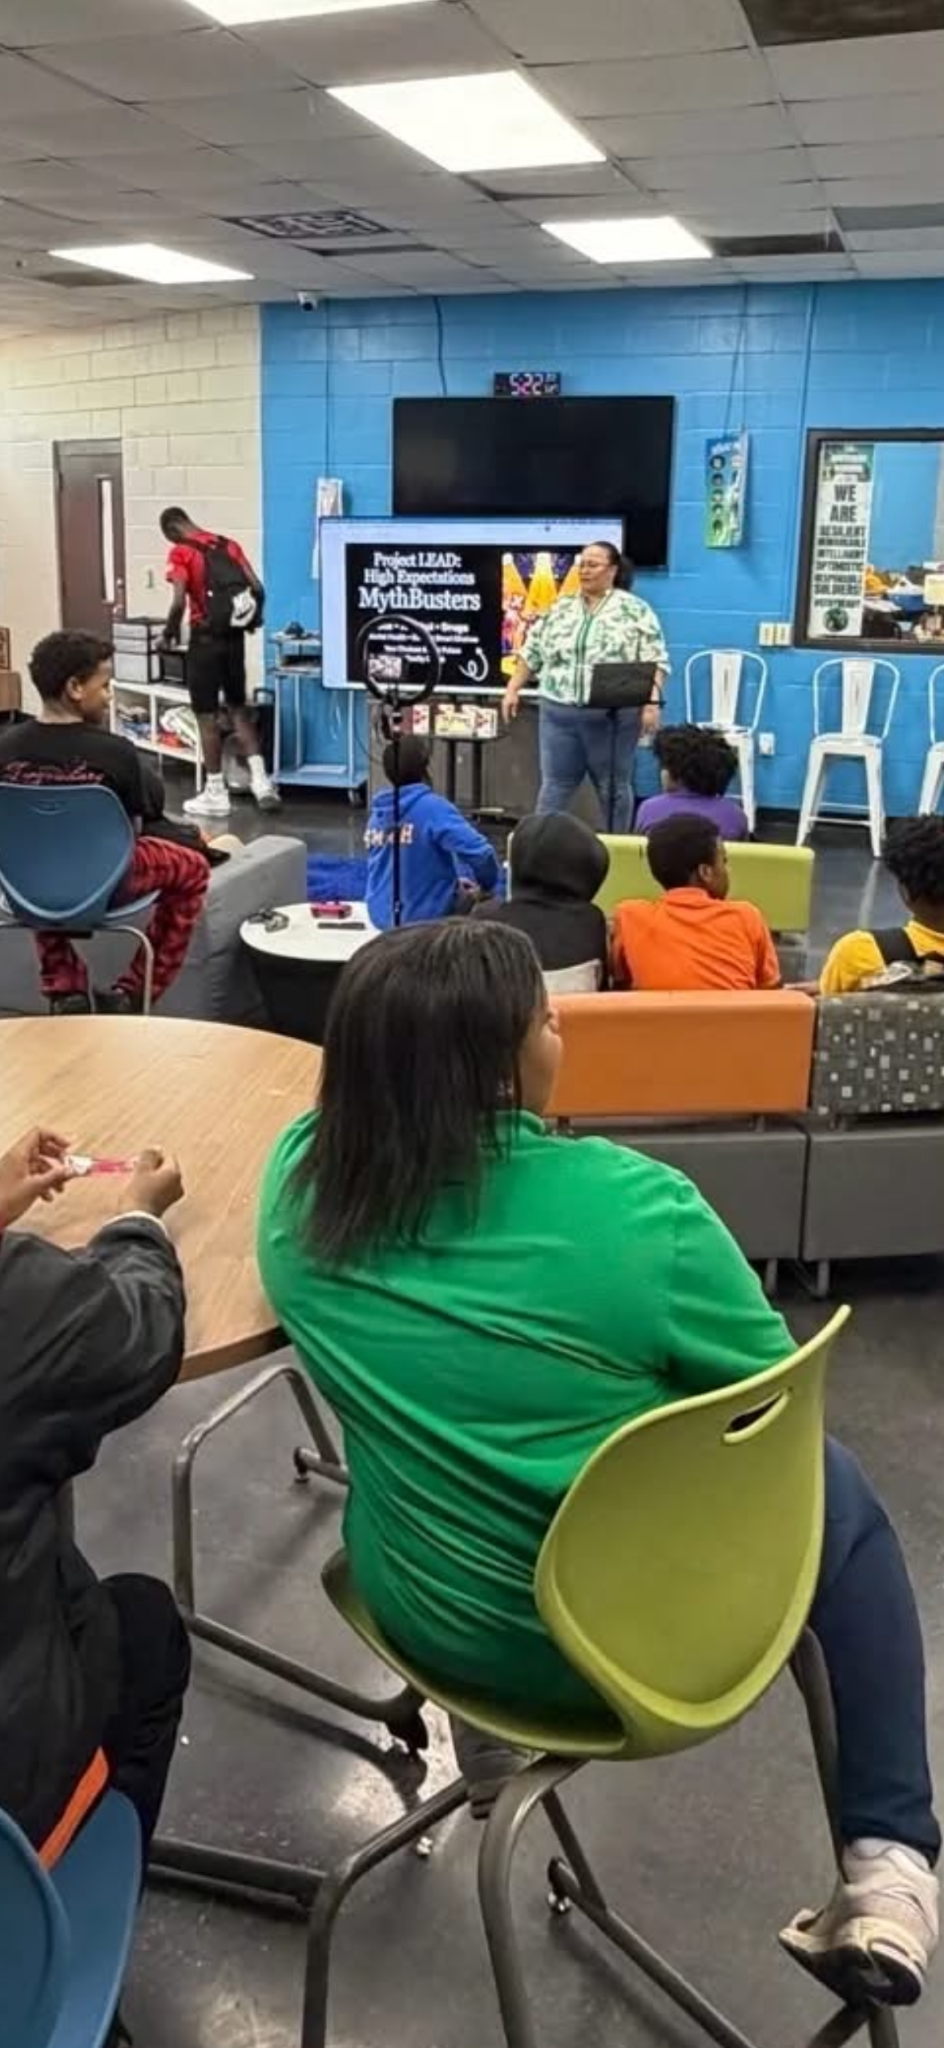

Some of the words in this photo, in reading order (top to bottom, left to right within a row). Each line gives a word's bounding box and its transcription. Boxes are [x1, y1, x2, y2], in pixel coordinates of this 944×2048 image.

[834, 485, 857, 502] WE
[830, 505, 858, 522] ARE
[373, 551, 417, 570] Project
[418, 552, 462, 567] LEAD:
[363, 568, 395, 587] High
[396, 569, 475, 587] Expectations
[358, 586, 481, 613] MythBusters
